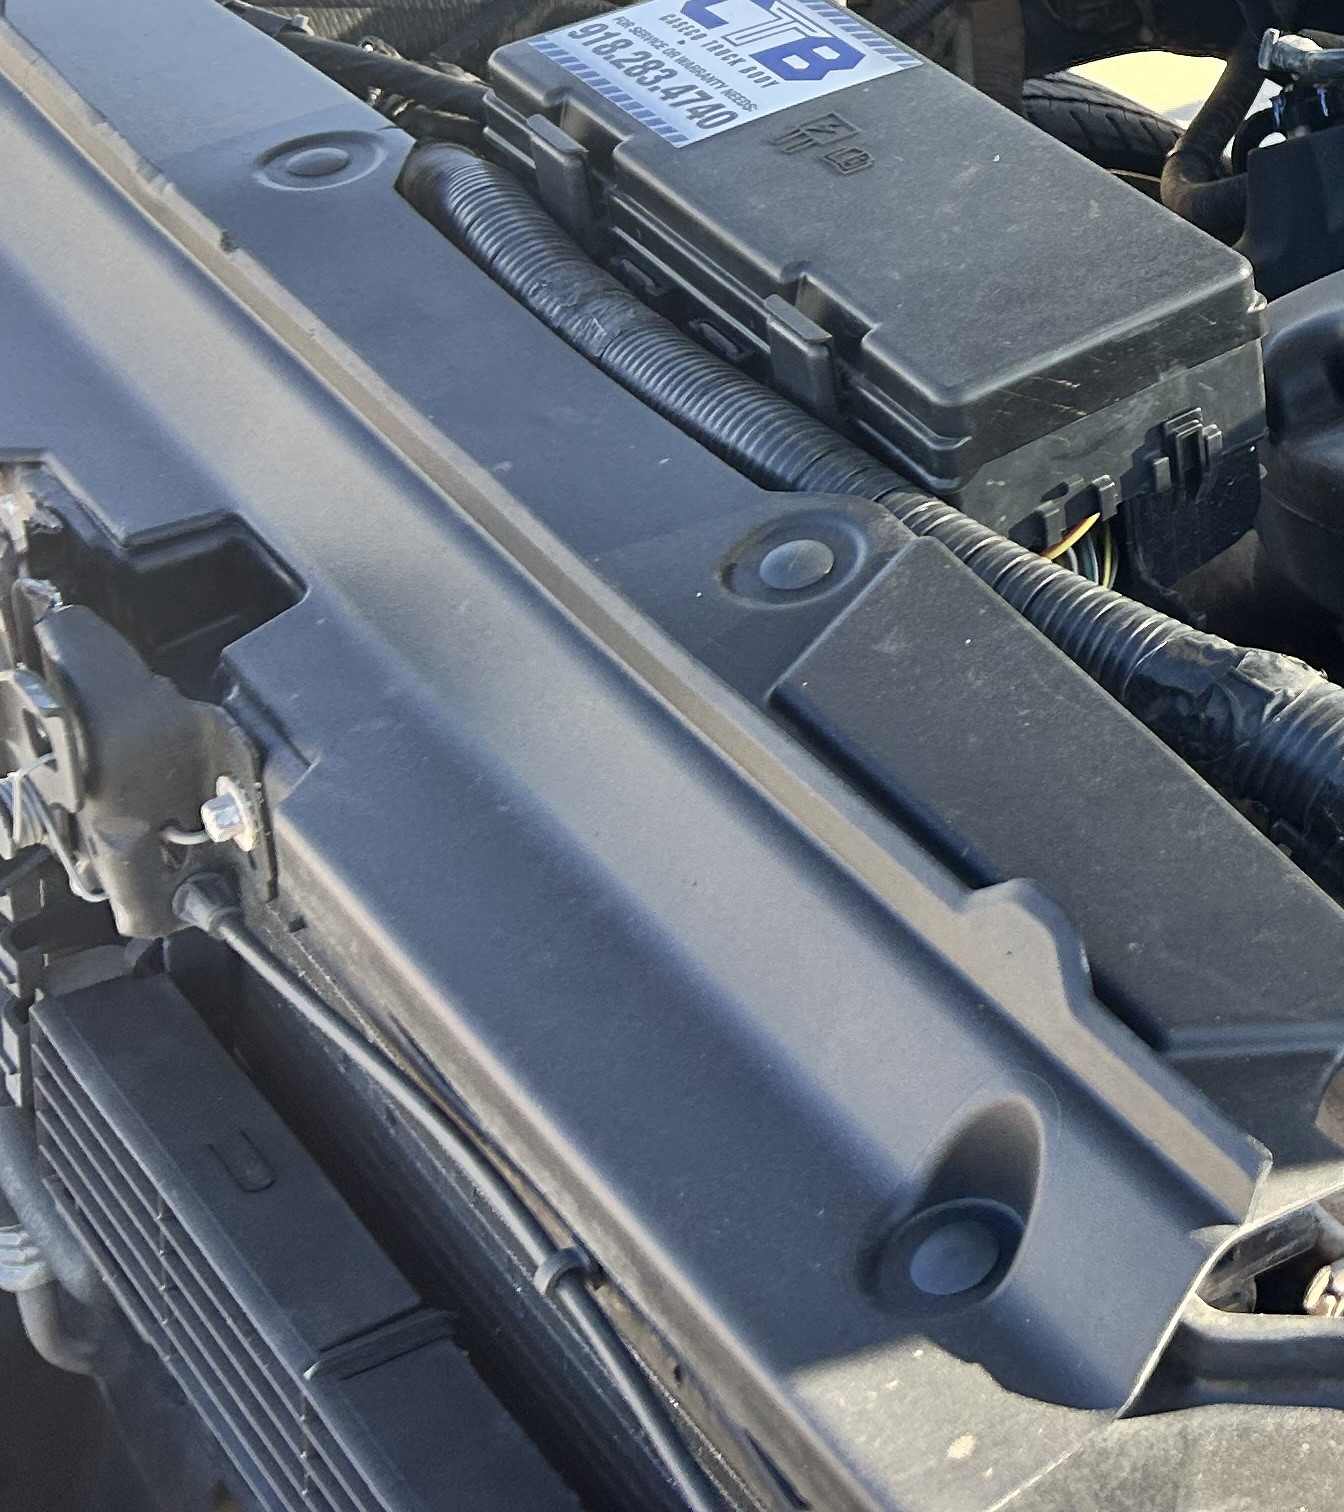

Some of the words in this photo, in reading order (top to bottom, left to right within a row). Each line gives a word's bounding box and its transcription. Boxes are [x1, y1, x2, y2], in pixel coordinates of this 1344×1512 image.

[568, 23, 739, 129] 918.283.4740
[612, 16, 636, 28] FOR
[628, 26, 669, 50] SERVICE
[661, 47, 681, 59] OR
[674, 55, 729, 89] WARRANTY
[659, 13, 708, 41] CASECO
[701, 39, 747, 66] TRUCK
[738, 66, 781, 88] BODY
